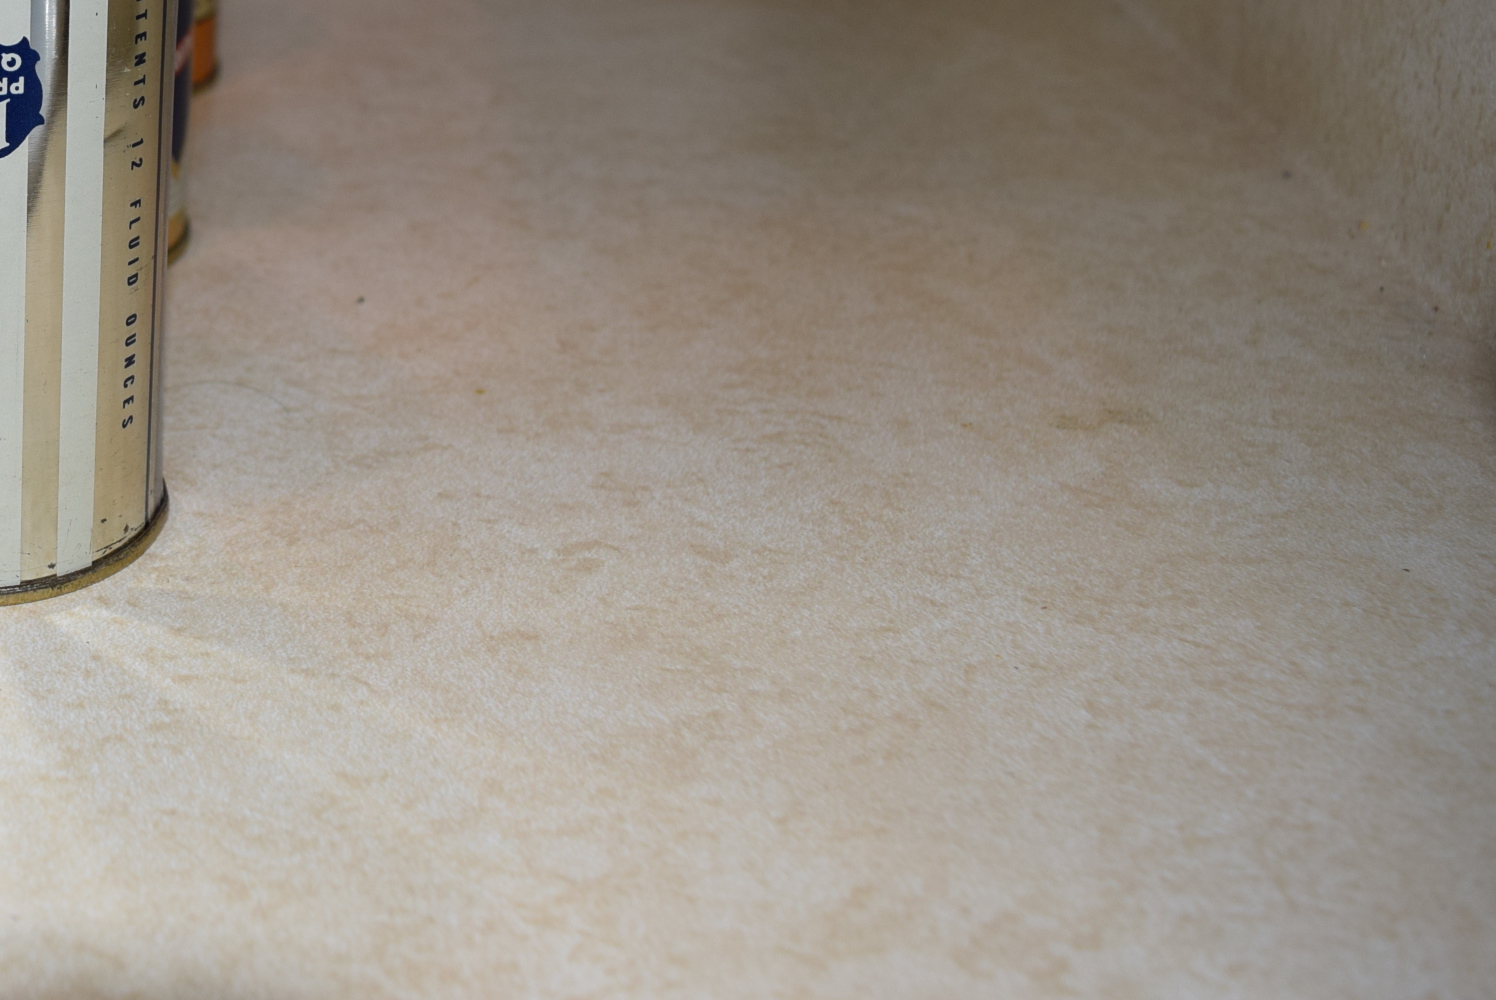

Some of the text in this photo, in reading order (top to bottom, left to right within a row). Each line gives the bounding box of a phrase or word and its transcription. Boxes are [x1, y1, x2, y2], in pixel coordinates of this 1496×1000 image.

[130, 137, 145, 171] 12
[126, 198, 142, 287] FLUID
[121, 312, 138, 429] OUNCES
